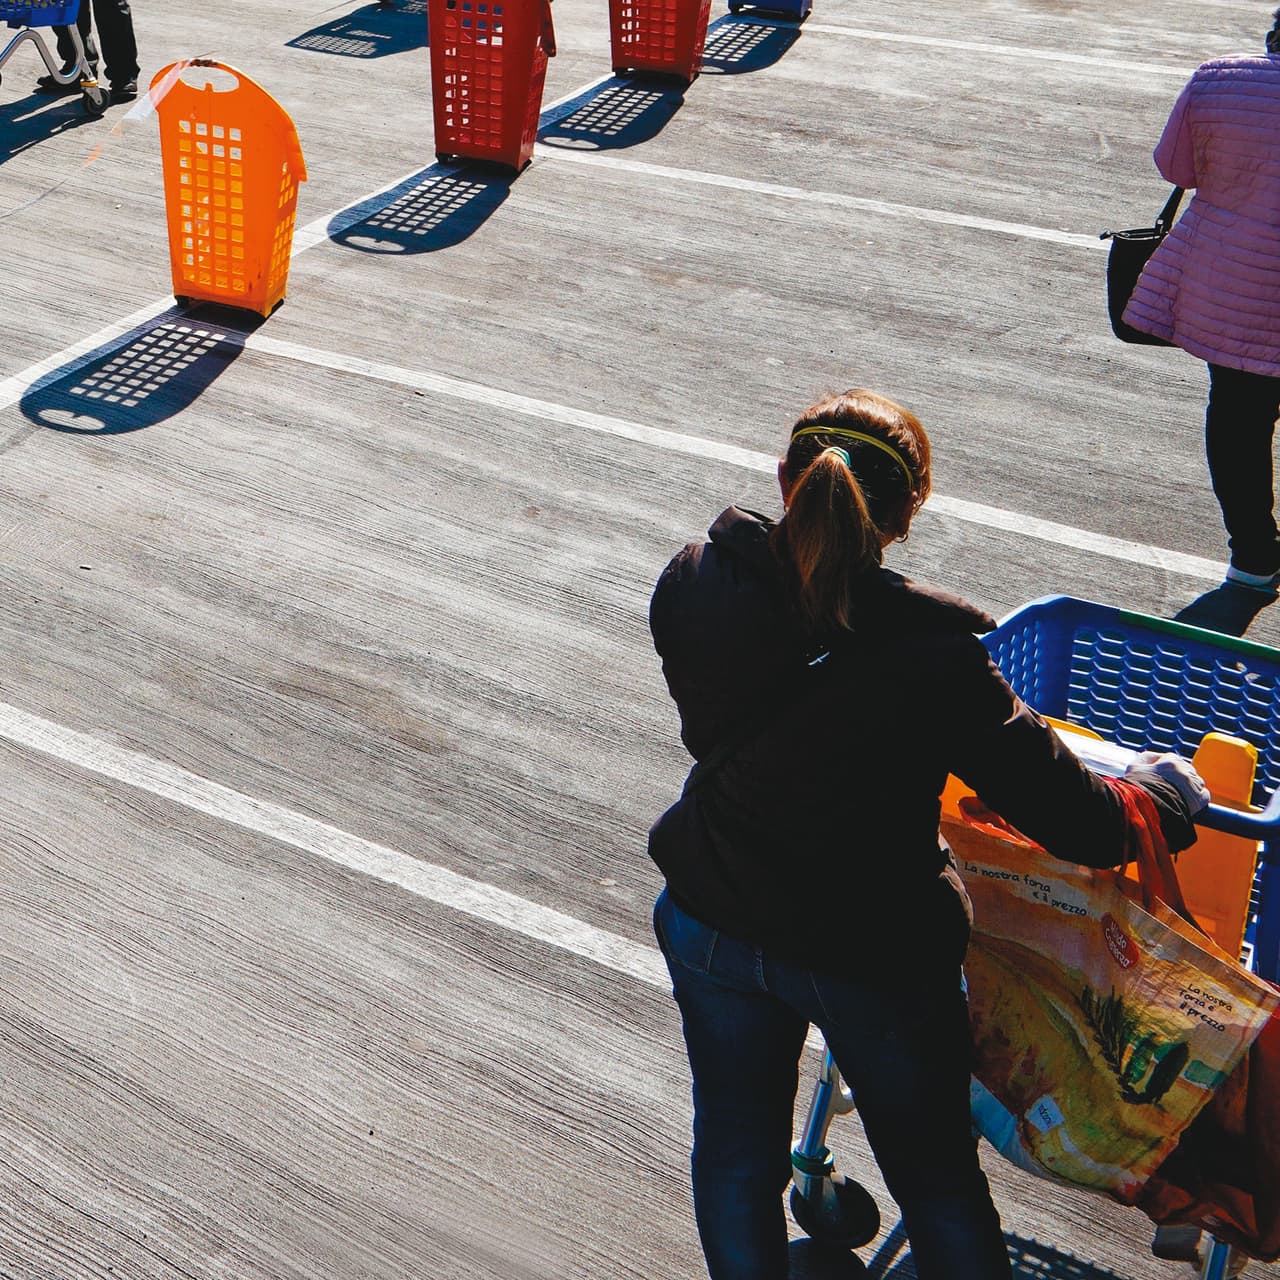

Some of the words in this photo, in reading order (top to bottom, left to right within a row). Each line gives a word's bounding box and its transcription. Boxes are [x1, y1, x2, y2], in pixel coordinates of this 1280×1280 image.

[965, 862, 977, 873] La
[981, 868, 1020, 881] nostra
[1023, 875, 1051, 893] forza
[1051, 899, 1087, 916] prezzo
[1187, 983, 1200, 994] La
[1202, 991, 1233, 1012] nostra
[1187, 1007, 1225, 1032] prezzo
